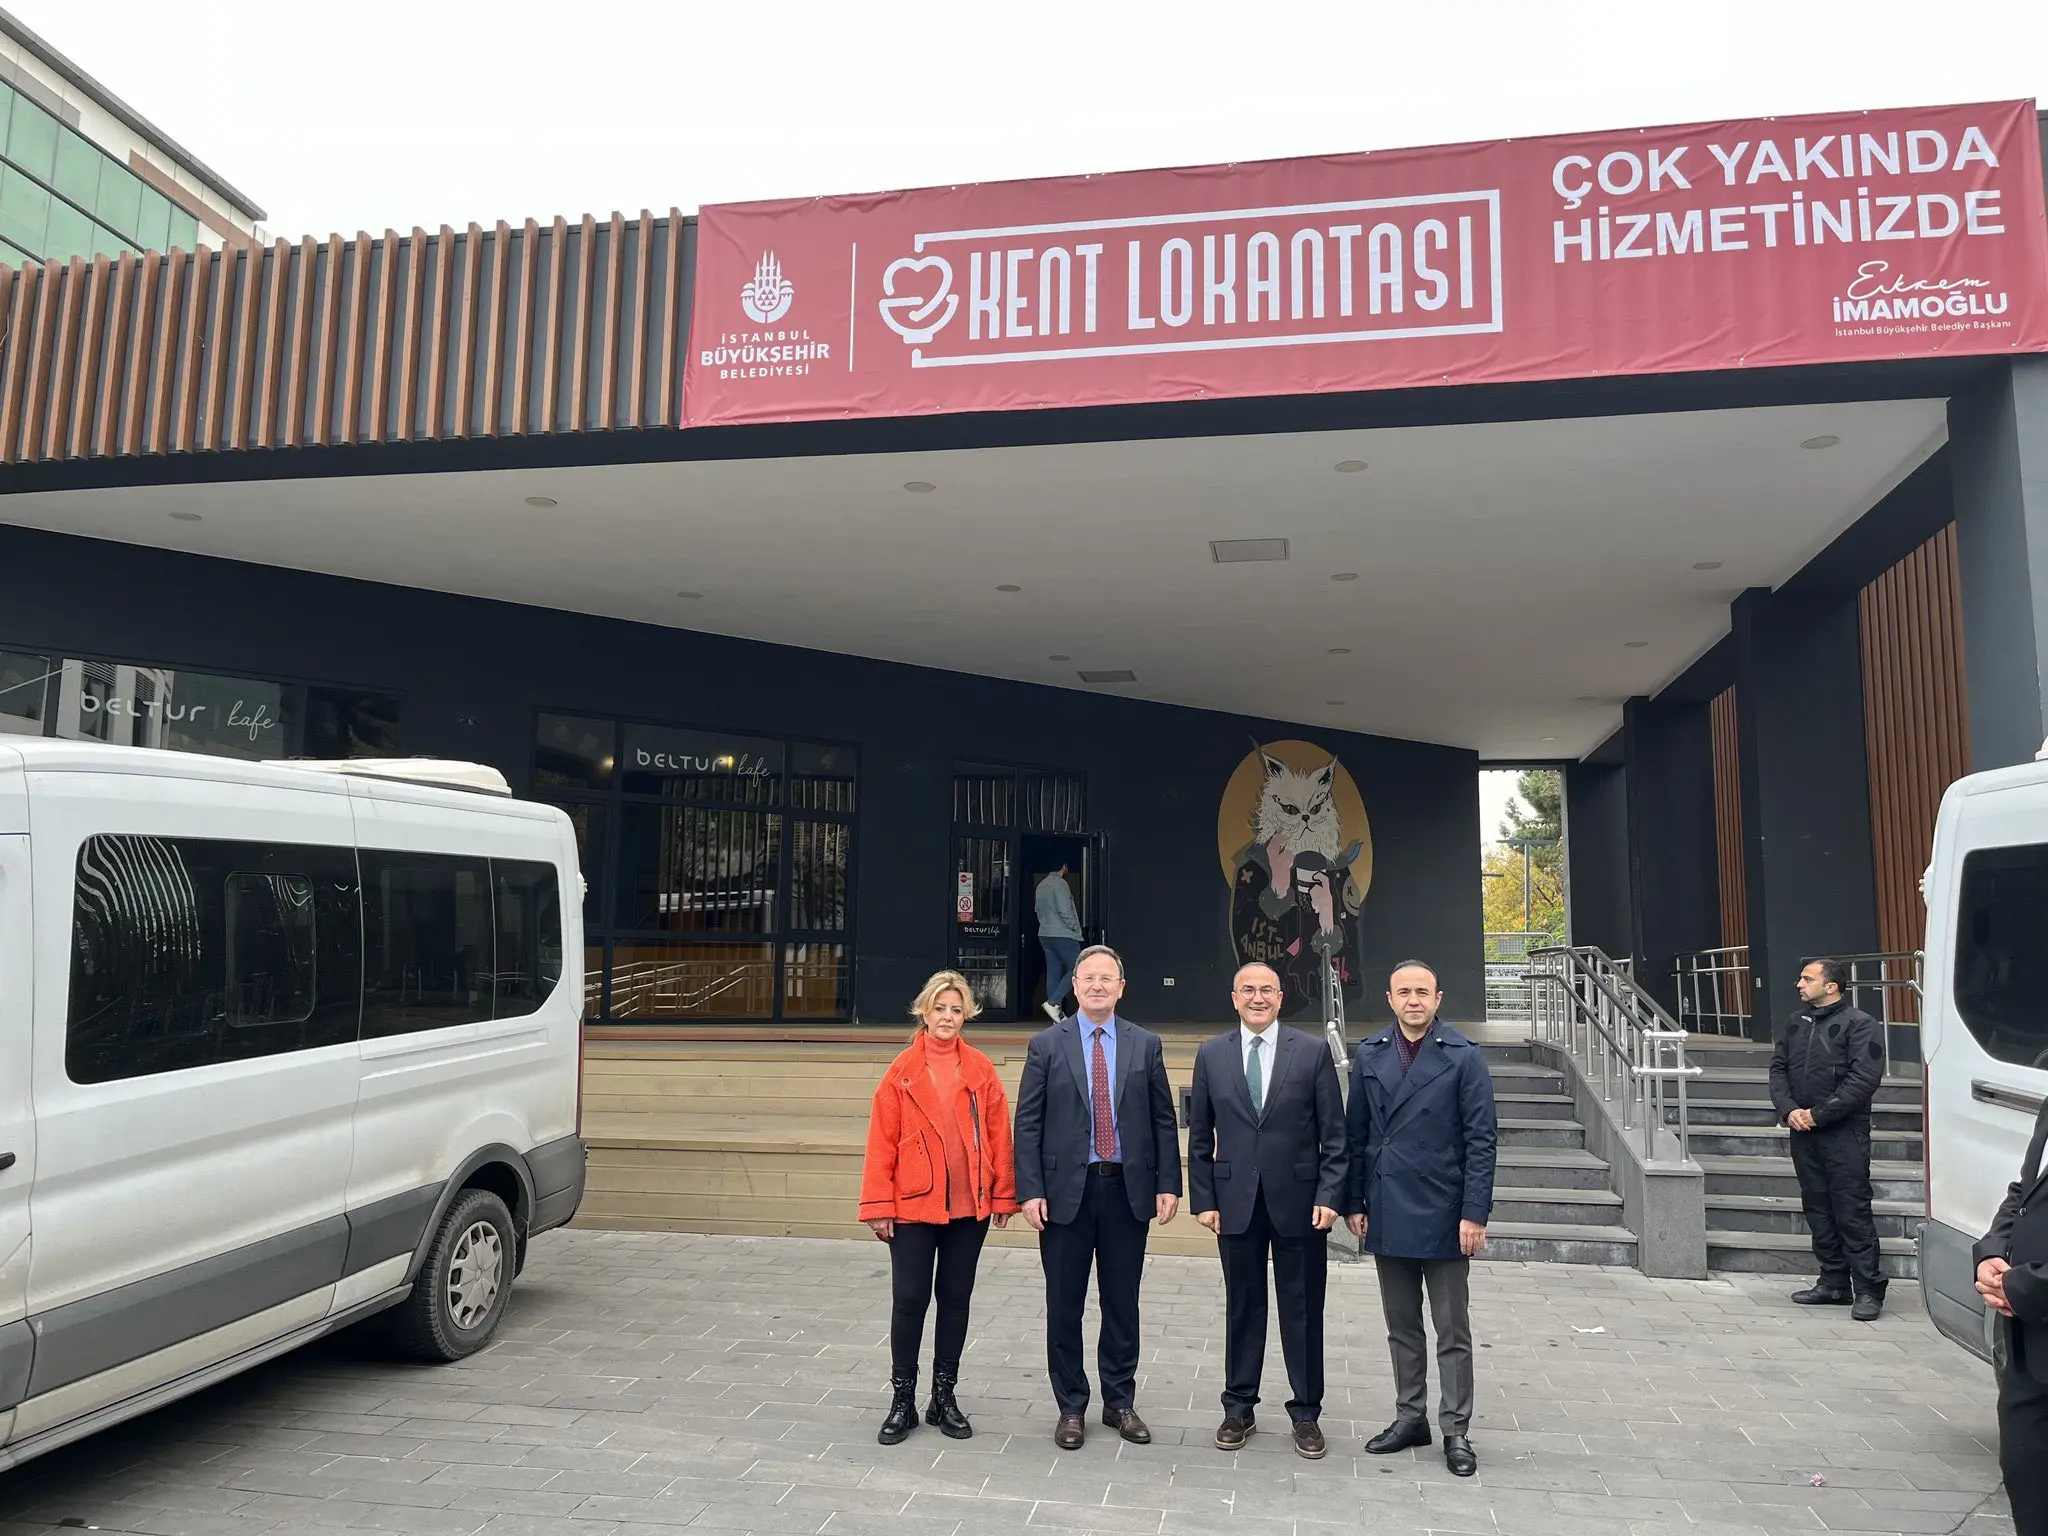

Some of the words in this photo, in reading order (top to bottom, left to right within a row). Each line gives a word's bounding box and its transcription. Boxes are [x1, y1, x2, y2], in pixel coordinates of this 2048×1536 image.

[1552, 146, 1692, 210] ÇOK
[1707, 126, 2000, 186] YAKINDA
[1553, 187, 2005, 264] HİZMETİNİZDE
[969, 243, 1104, 340] KENT
[1128, 216, 1473, 330] LOKANTASI
[1833, 290, 2008, 323] İMAMOĞLU
[721, 331, 810, 344] İSTANBUL
[1876, 323, 1928, 336] Büyükşehir
[1931, 321, 1971, 333] Belediye
[1973, 319, 2011, 332] Başkanı
[701, 342, 830, 367] BÜYÜKŞEHİR
[719, 364, 810, 379] BELEDİYESİ
[227, 700, 275, 742] kafe
[737, 753, 770, 787] kafe
